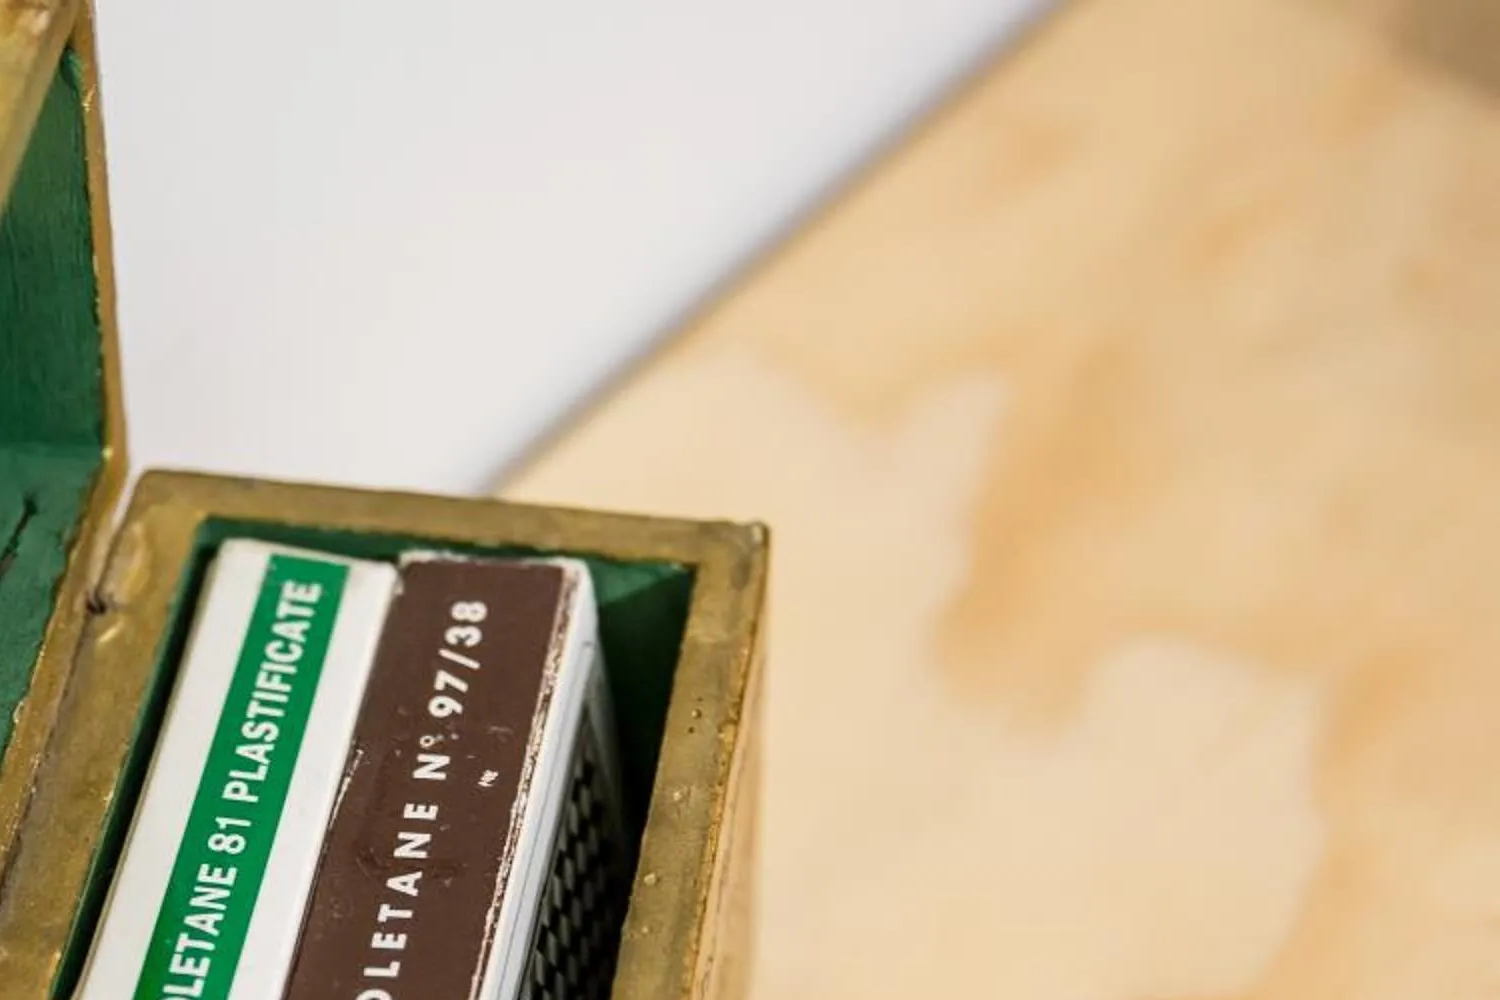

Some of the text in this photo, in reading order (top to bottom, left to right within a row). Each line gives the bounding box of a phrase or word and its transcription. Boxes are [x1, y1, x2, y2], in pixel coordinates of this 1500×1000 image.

[221, 579, 321, 803] PLASTIFICATE
[427, 600, 488, 718] 97/38
[207, 816, 252, 855] 81
